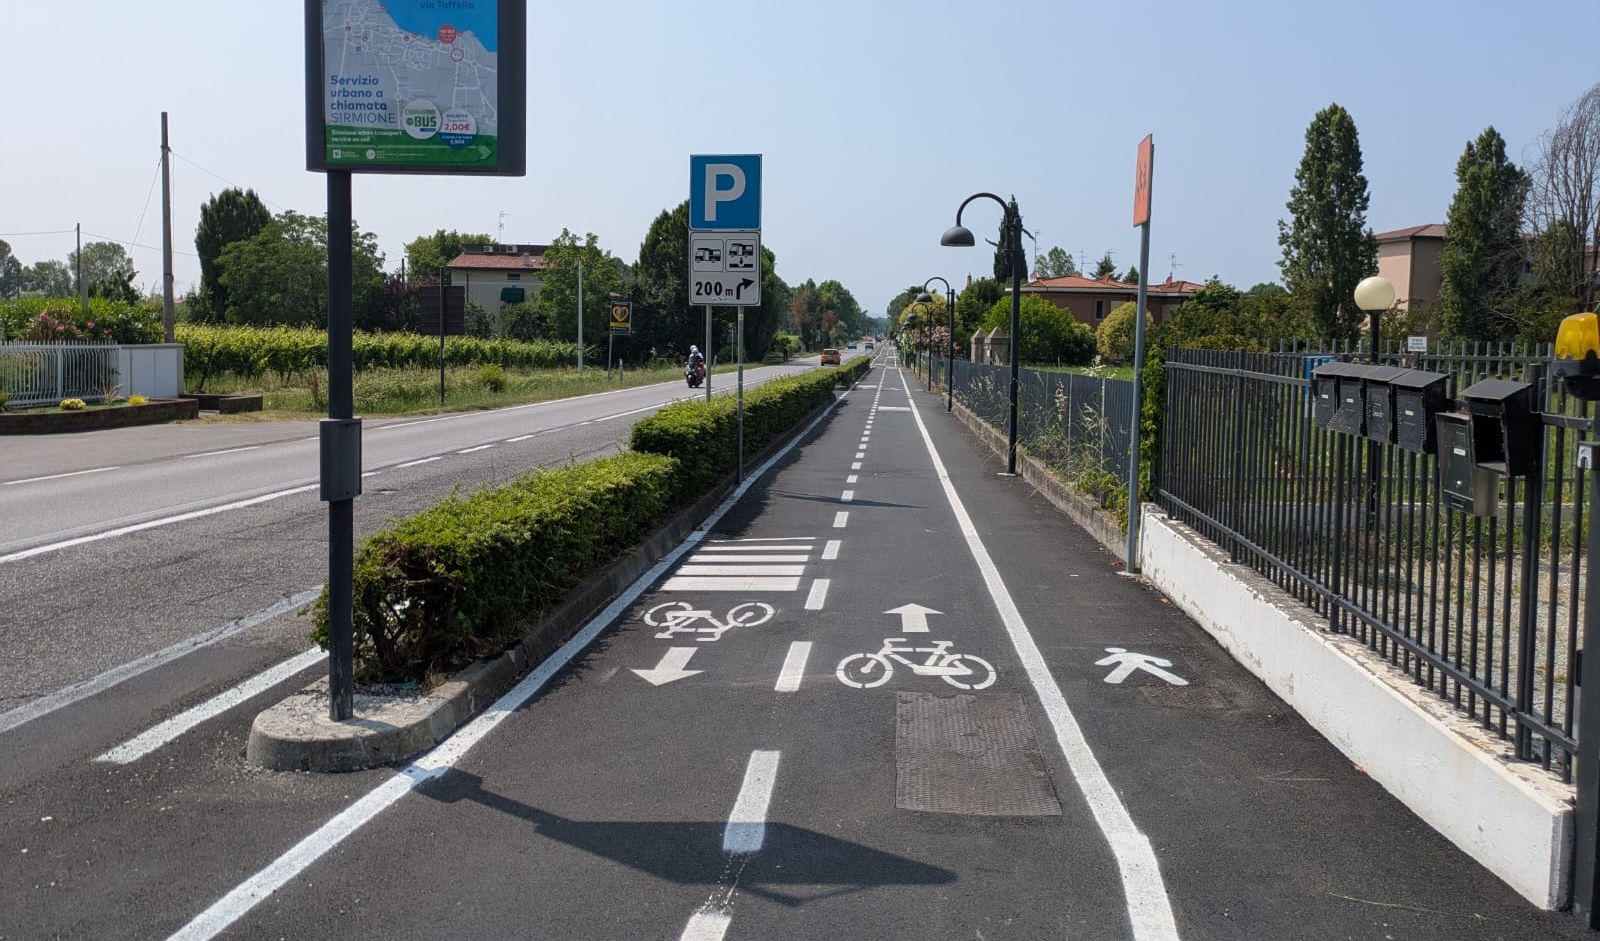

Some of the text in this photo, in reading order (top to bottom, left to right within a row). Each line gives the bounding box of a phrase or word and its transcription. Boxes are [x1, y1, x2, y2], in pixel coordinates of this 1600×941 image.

[330, 75, 379, 85] Servizio
[331, 88, 372, 97] urbano
[331, 101, 387, 110] chiamata
[331, 113, 396, 123] SIRMIONE
[414, 116, 436, 127] BUS
[444, 123, 471, 132] 2,00€
[704, 163, 746, 222] P
[695, 281, 733, 296] 200 m
